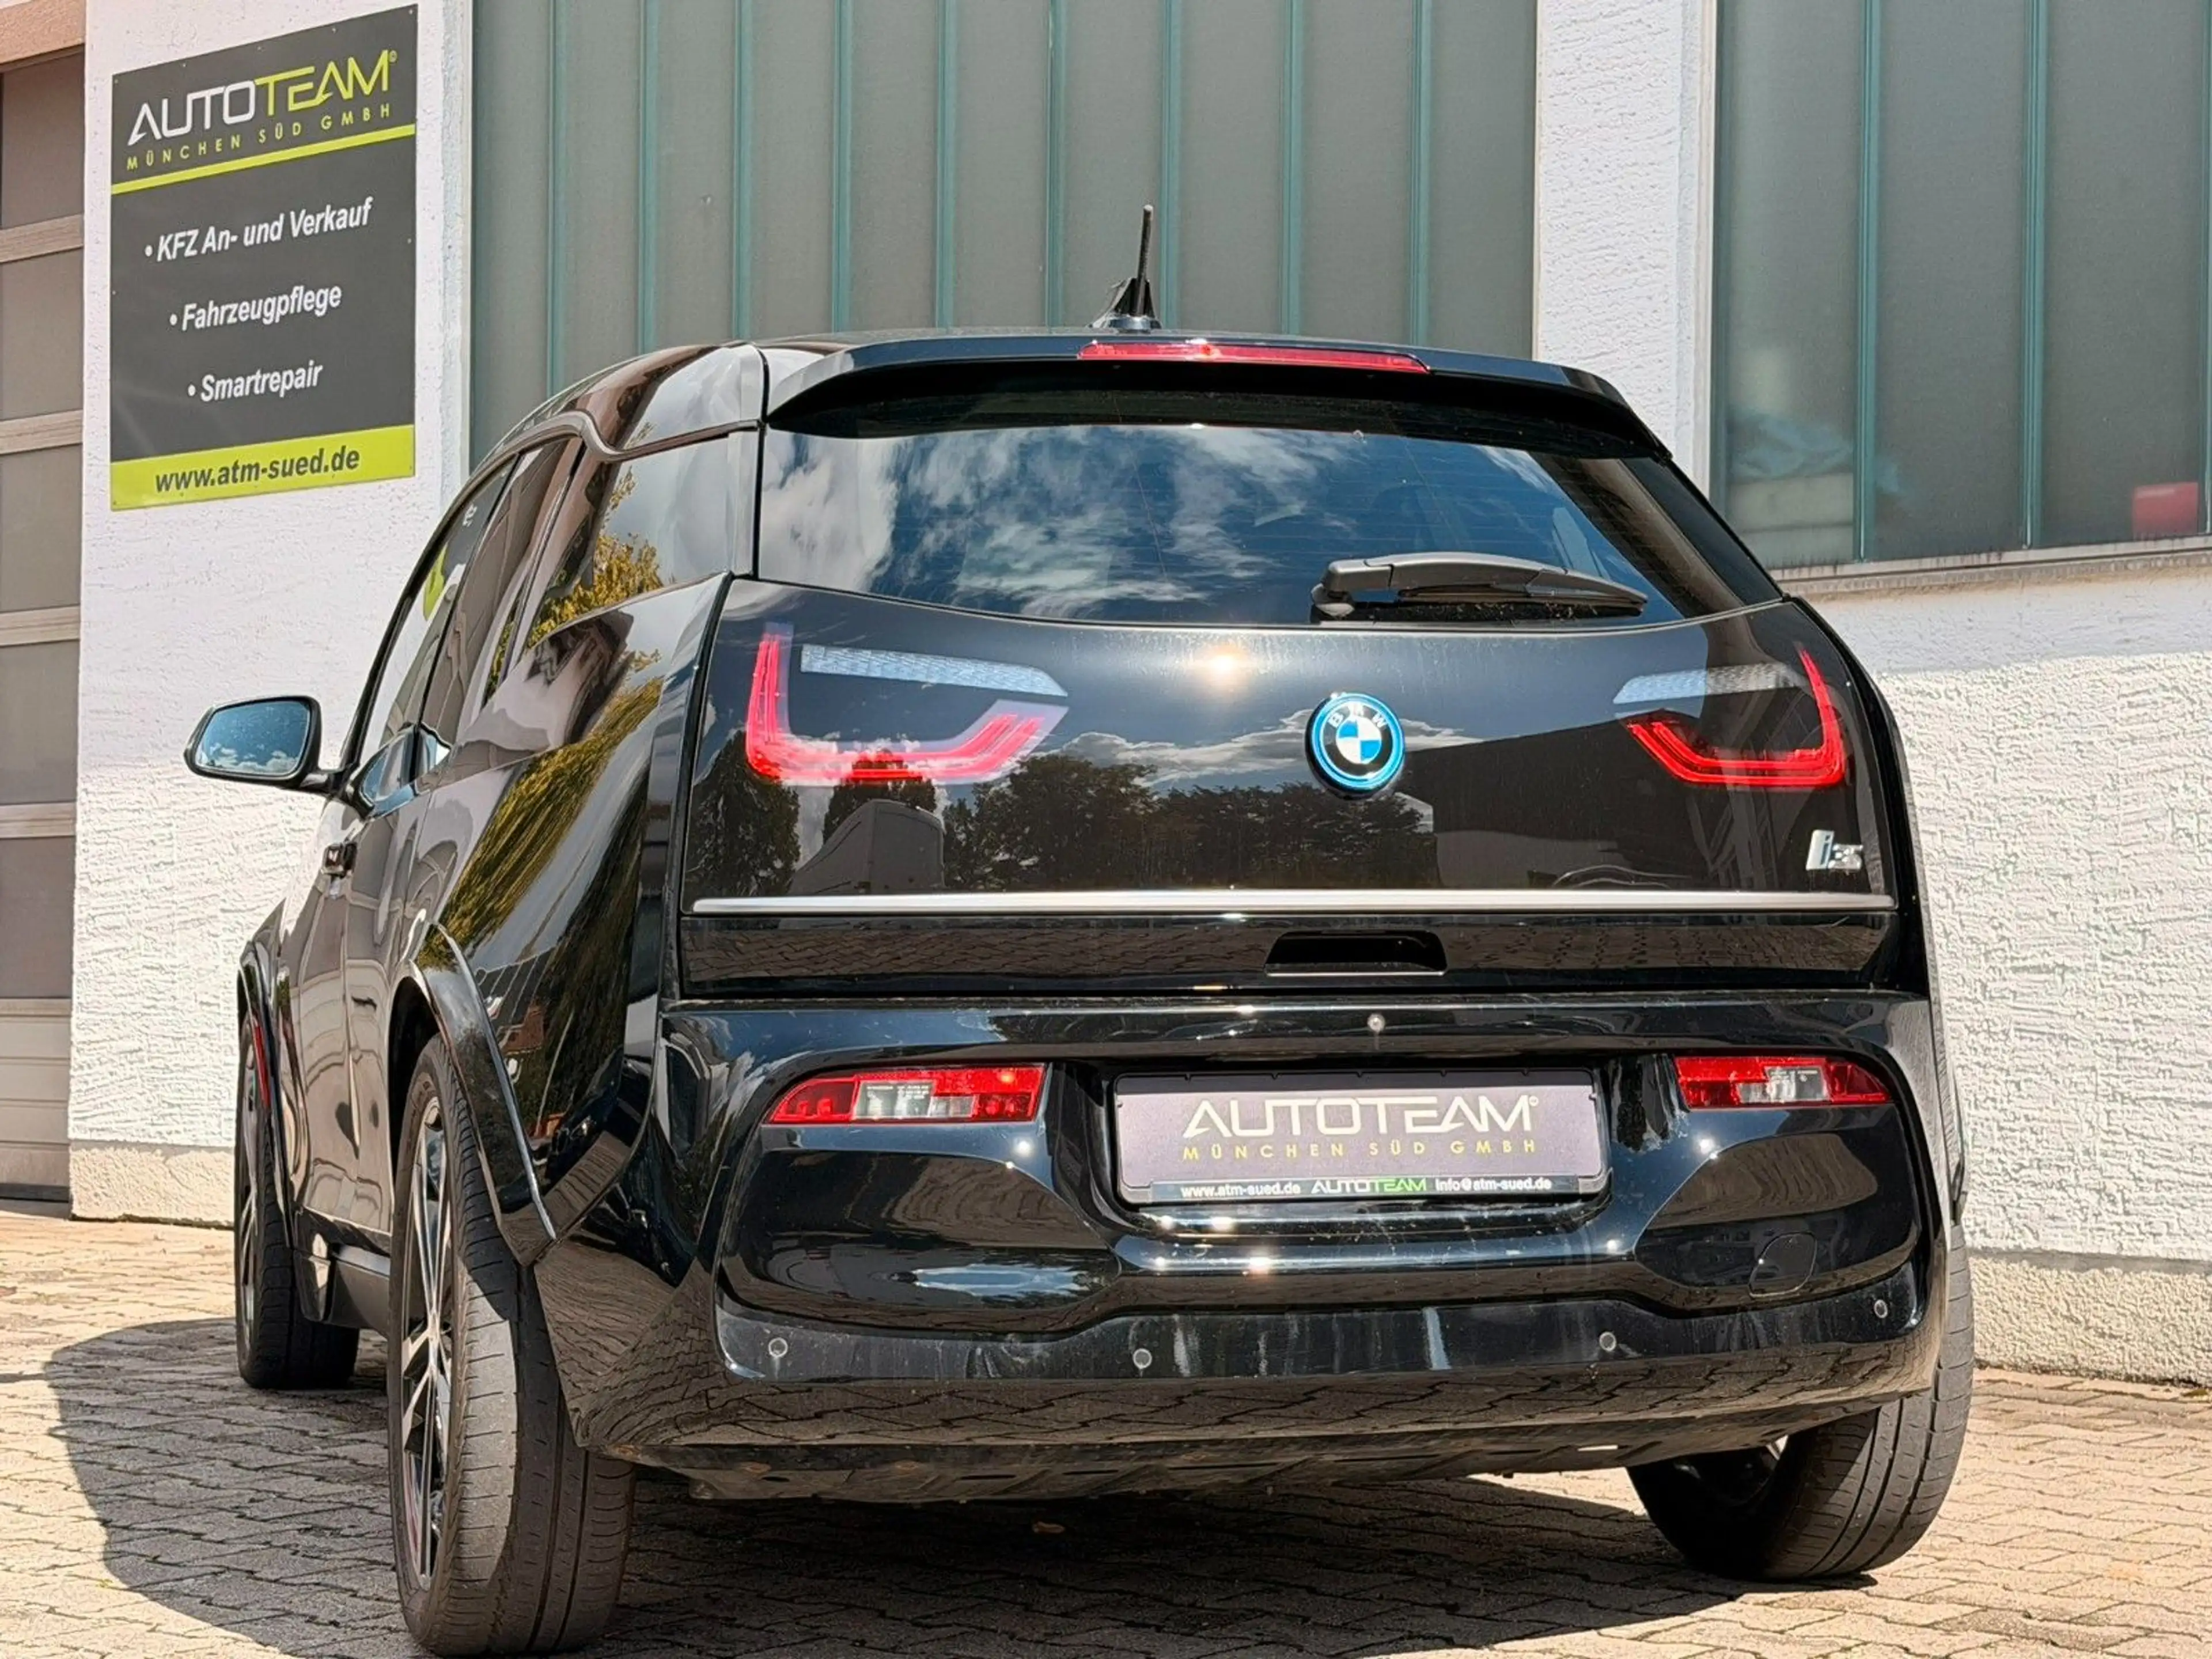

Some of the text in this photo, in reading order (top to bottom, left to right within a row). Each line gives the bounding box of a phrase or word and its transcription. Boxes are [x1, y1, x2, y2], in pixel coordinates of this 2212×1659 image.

[126, 104, 389, 171] MÜNCHEN SÜD GMBH
[156, 196, 374, 262] KFZ An- und Verkauf
[181, 285, 342, 332] Fahrzeugpflege
[200, 360, 323, 402] Smartrepair
[155, 445, 360, 493] www.atm-sued.de
[1328, 701, 1388, 729] BMW
[1182, 1139, 1536, 1160] MÜNCHEN SÜD GMBH
[1181, 1181, 1301, 1198] www.atm-sued.de
[1311, 1179, 1427, 1194] AUTOTEAM
